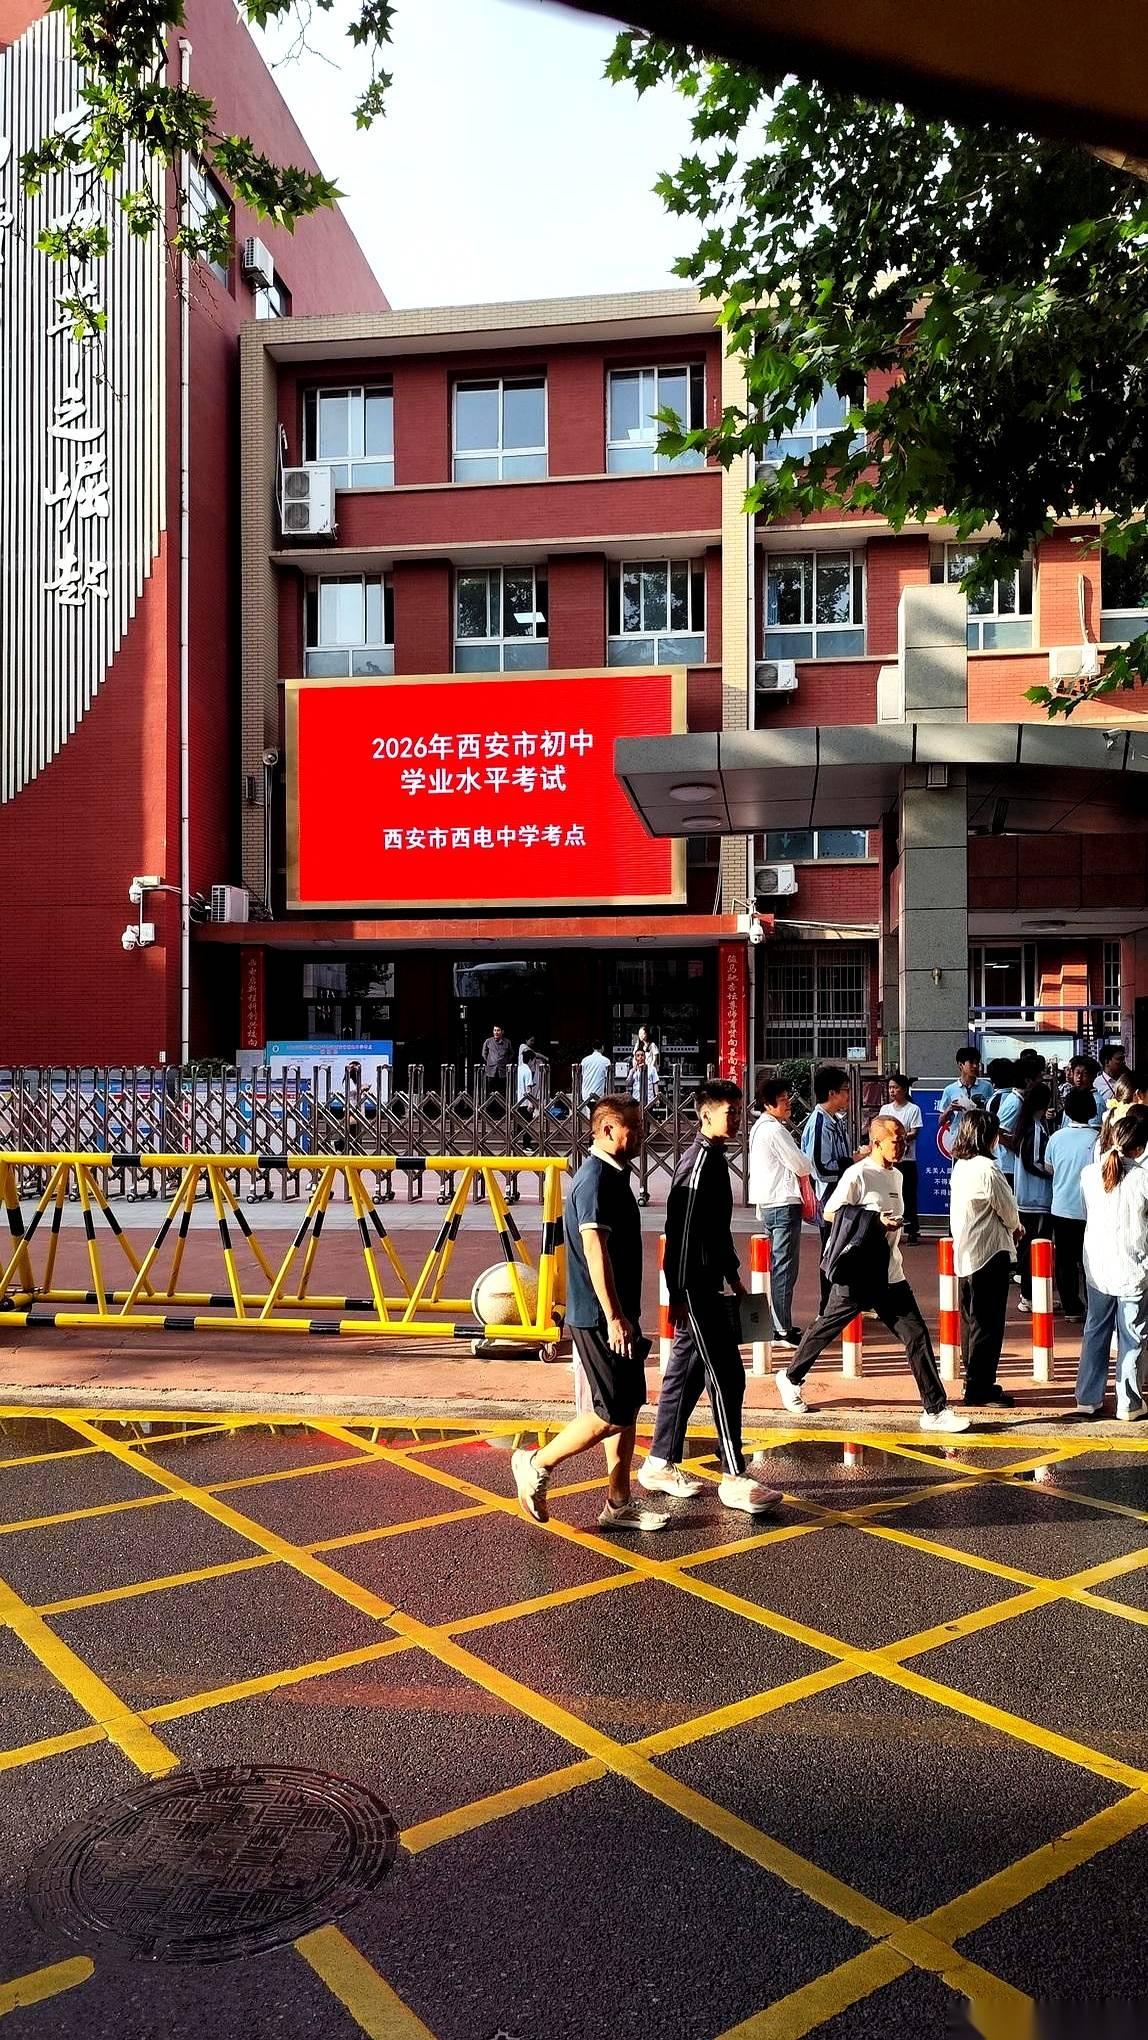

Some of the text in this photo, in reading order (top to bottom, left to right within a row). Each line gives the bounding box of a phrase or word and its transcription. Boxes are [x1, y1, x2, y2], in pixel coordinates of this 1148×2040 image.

[371, 728, 594, 761] 2026年西安市初中
[400, 764, 567, 796] 学业水平考试
[383, 823, 587, 850] 西安市西电中学考点
